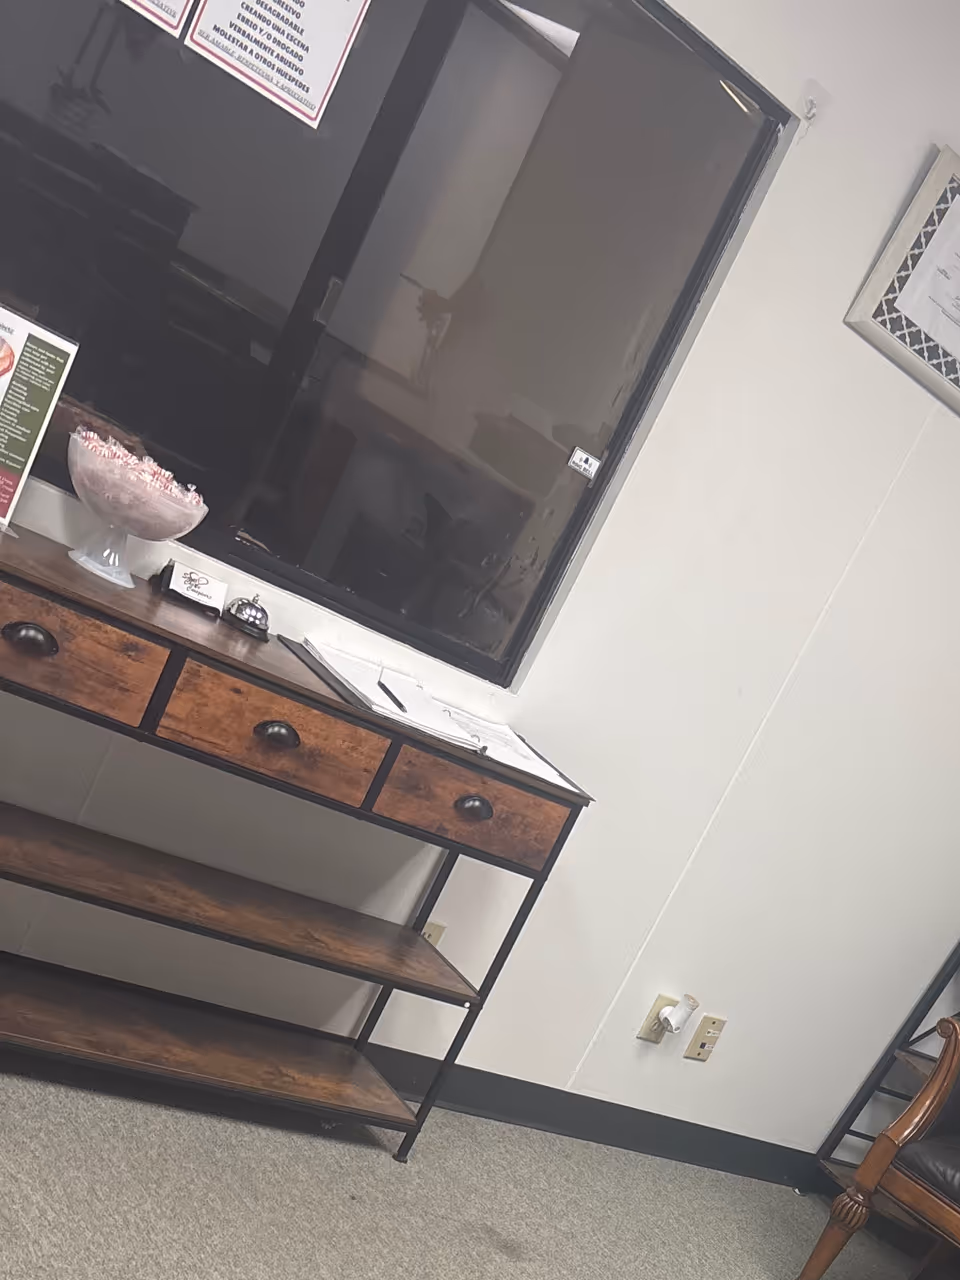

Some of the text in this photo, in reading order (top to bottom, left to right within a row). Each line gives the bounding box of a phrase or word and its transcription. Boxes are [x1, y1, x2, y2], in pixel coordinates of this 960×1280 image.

[237, 12, 258, 31] EBRIO
[272, 37, 304, 62] DROGADO
[241, 1, 309, 53] CREANDO UNA ESCENA
[255, 0, 304, 36] DESAGRADABLE
[212, 24, 310, 93] MOLESTAR A OTROS HUESPEDES
[229, 21, 304, 76] VERBALMENTE ABUSIVO
